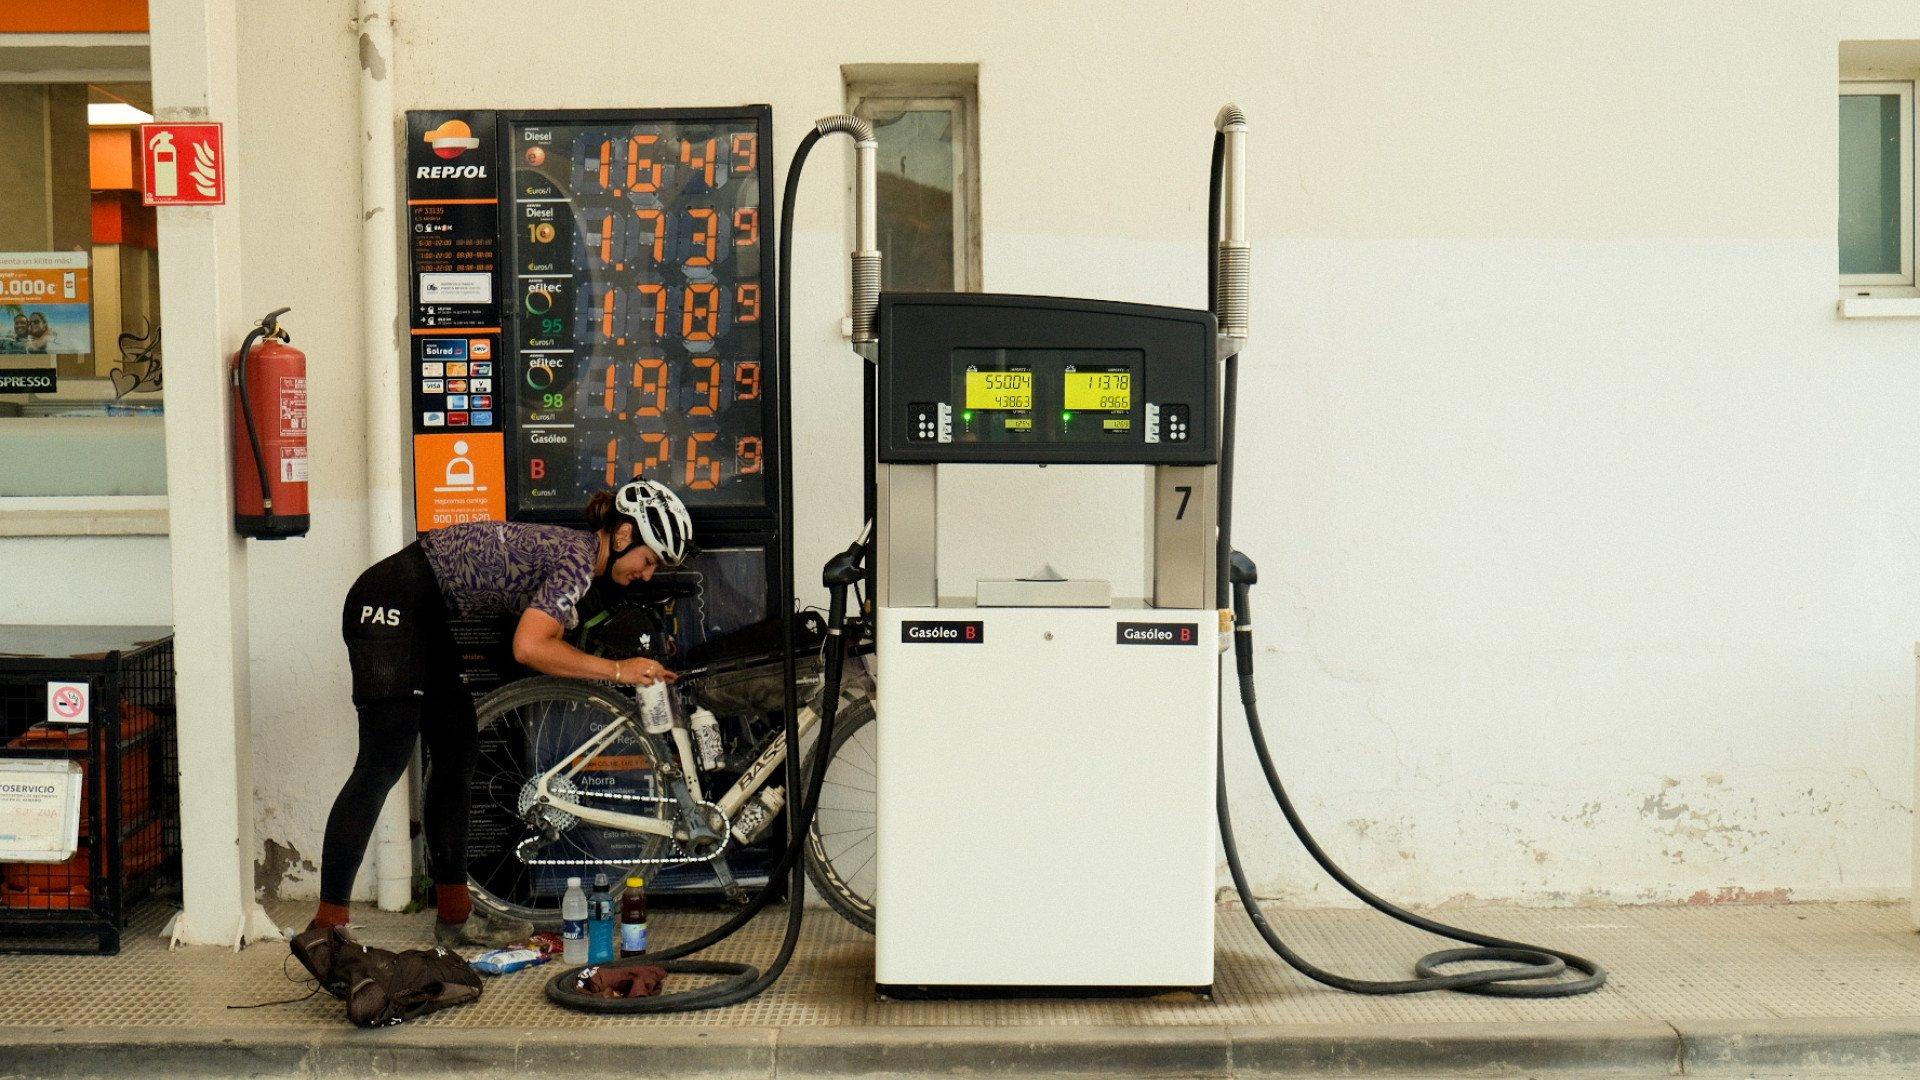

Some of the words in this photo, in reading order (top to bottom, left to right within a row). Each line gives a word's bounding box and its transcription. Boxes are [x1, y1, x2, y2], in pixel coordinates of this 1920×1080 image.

[524, 130, 552, 141] Diesel
[416, 165, 488, 179] REPSOL
[526, 207, 554, 218] Diesel
[528, 283, 562, 293] efitec
[541, 318, 562, 333] 95
[426, 347, 453, 355] Solred
[529, 358, 563, 368] efitec
[542, 393, 564, 408] 98
[530, 433, 567, 444] Gasóleo
[530, 458, 546, 480] B
[1175, 486, 1192, 520] 7
[433, 514, 452, 524] 900
[454, 514, 469, 524] 101
[360, 605, 401, 627] PAS
[908, 625, 958, 639] Gasóleo
[965, 625, 976, 640] B
[1123, 627, 1173, 641] Gasóleo
[1180, 628, 1191, 642] B
[581, 775, 616, 786] Ahorra
